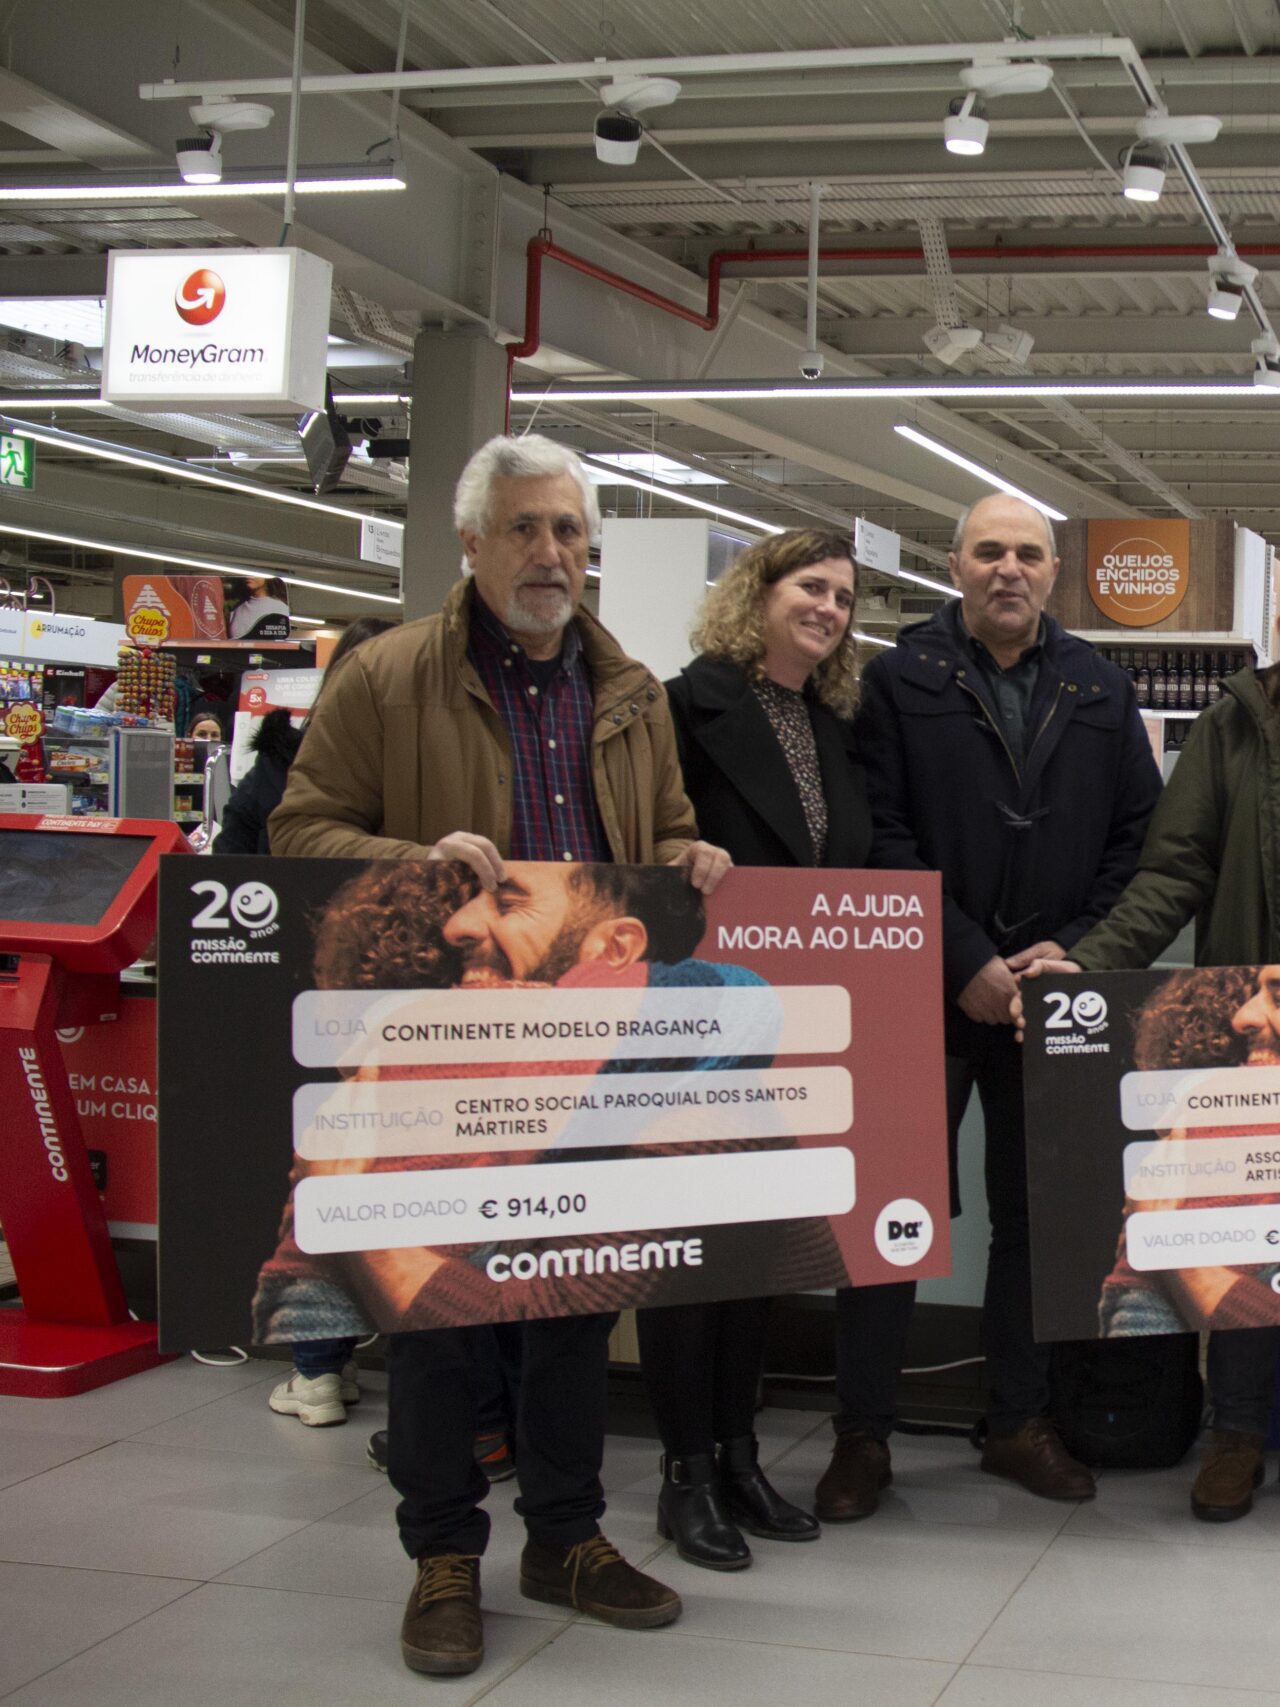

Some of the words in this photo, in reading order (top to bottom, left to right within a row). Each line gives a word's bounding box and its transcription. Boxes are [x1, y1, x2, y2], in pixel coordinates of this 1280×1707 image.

[130, 343, 264, 368] MoneyGram
[1103, 554, 1174, 569] QUEIJOS
[1096, 568, 1180, 582] ENCHIDOS
[1100, 582, 1109, 595] E
[1113, 582, 1176, 595] VINHOS
[133, 615, 165, 627] Chupa
[36, 623, 86, 638] ARRUMAÇÃO
[131, 624, 163, 637] Chups
[10, 713, 37, 725] Chupa
[9, 724, 37, 738] Chups
[811, 894, 831, 916] A
[837, 894, 924, 917] AJUDA
[250, 921, 281, 939] anos
[718, 926, 802, 949] MORA
[810, 926, 848, 949] AO
[855, 926, 924, 950] LADO
[191, 937, 247, 951] MISSÃO
[191, 952, 280, 964] CONTINENTE
[314, 1019, 367, 1037] LOJA
[382, 1023, 516, 1042] CONTINENTE
[522, 1021, 610, 1040] MODELO
[617, 1019, 722, 1039] BRAGANÇA
[1087, 1021, 1109, 1035] anos
[1045, 1033, 1086, 1046] MISSÃO
[1045, 1043, 1110, 1055] CONTINENTE
[68, 1073, 96, 1091] EM
[100, 1075, 150, 1095] CASA
[455, 1098, 529, 1115] CENTRO
[535, 1091, 598, 1112] SOCIAL
[604, 1090, 702, 1110] PAROQUIAL
[706, 1089, 740, 1104] DOS
[745, 1086, 808, 1103] SANTOS
[1137, 1091, 1177, 1107] LOJA
[19, 1047, 69, 1182] CONTINENTE
[77, 1100, 106, 1118] UM
[111, 1102, 158, 1122] CLIQ
[315, 1106, 444, 1131] INSTITUIÇÃO
[456, 1117, 548, 1137] MÁRTIRES
[1140, 1158, 1237, 1178] INSTITUIÇÃO
[317, 1204, 386, 1223] VALOR
[393, 1199, 467, 1218] DOADO
[478, 1201, 498, 1219] €
[507, 1195, 587, 1219] 914,00
[1144, 1233, 1195, 1249] VALOR
[1199, 1229, 1256, 1245] DOADO
[1264, 1229, 1280, 1245] €
[486, 1239, 703, 1284] CONTINENTE
